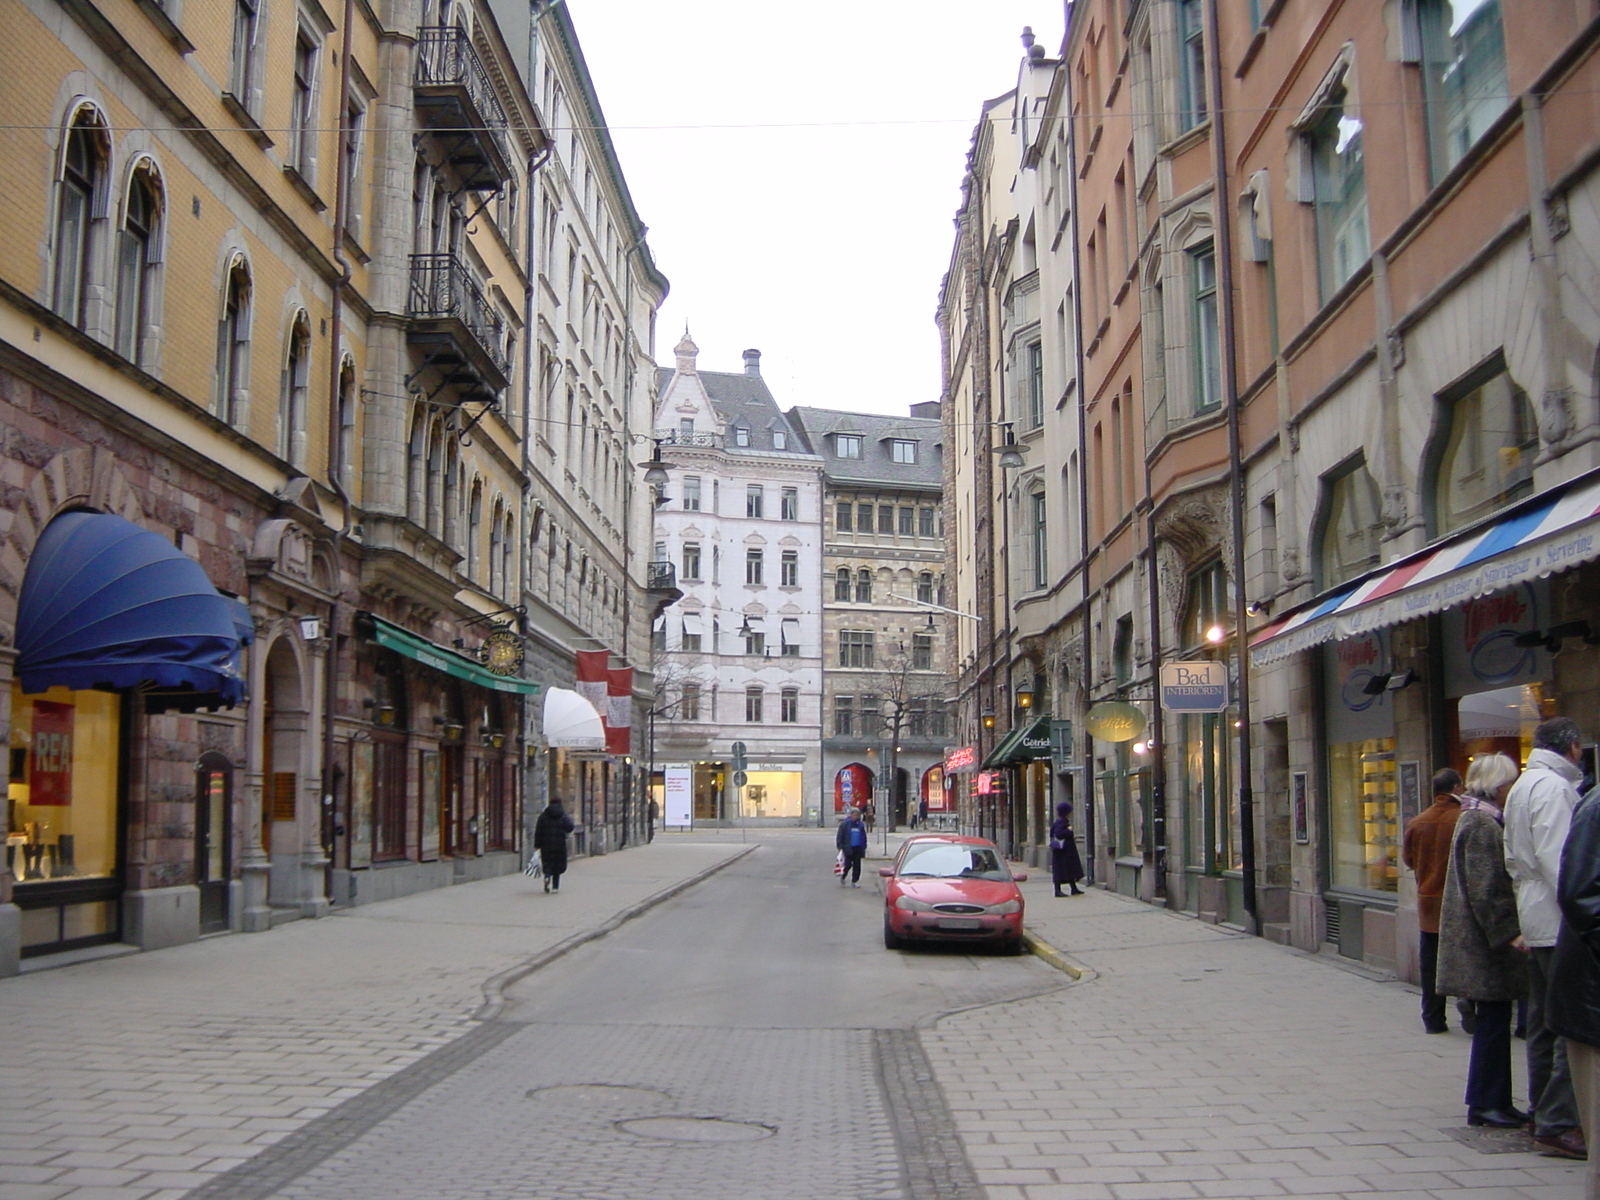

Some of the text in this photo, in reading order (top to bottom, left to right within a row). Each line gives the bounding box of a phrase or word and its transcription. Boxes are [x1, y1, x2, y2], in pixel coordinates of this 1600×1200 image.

[1546, 532, 1594, 565] Servering
[1174, 667, 1211, 686] Bad
[36, 731, 71, 774] REA
